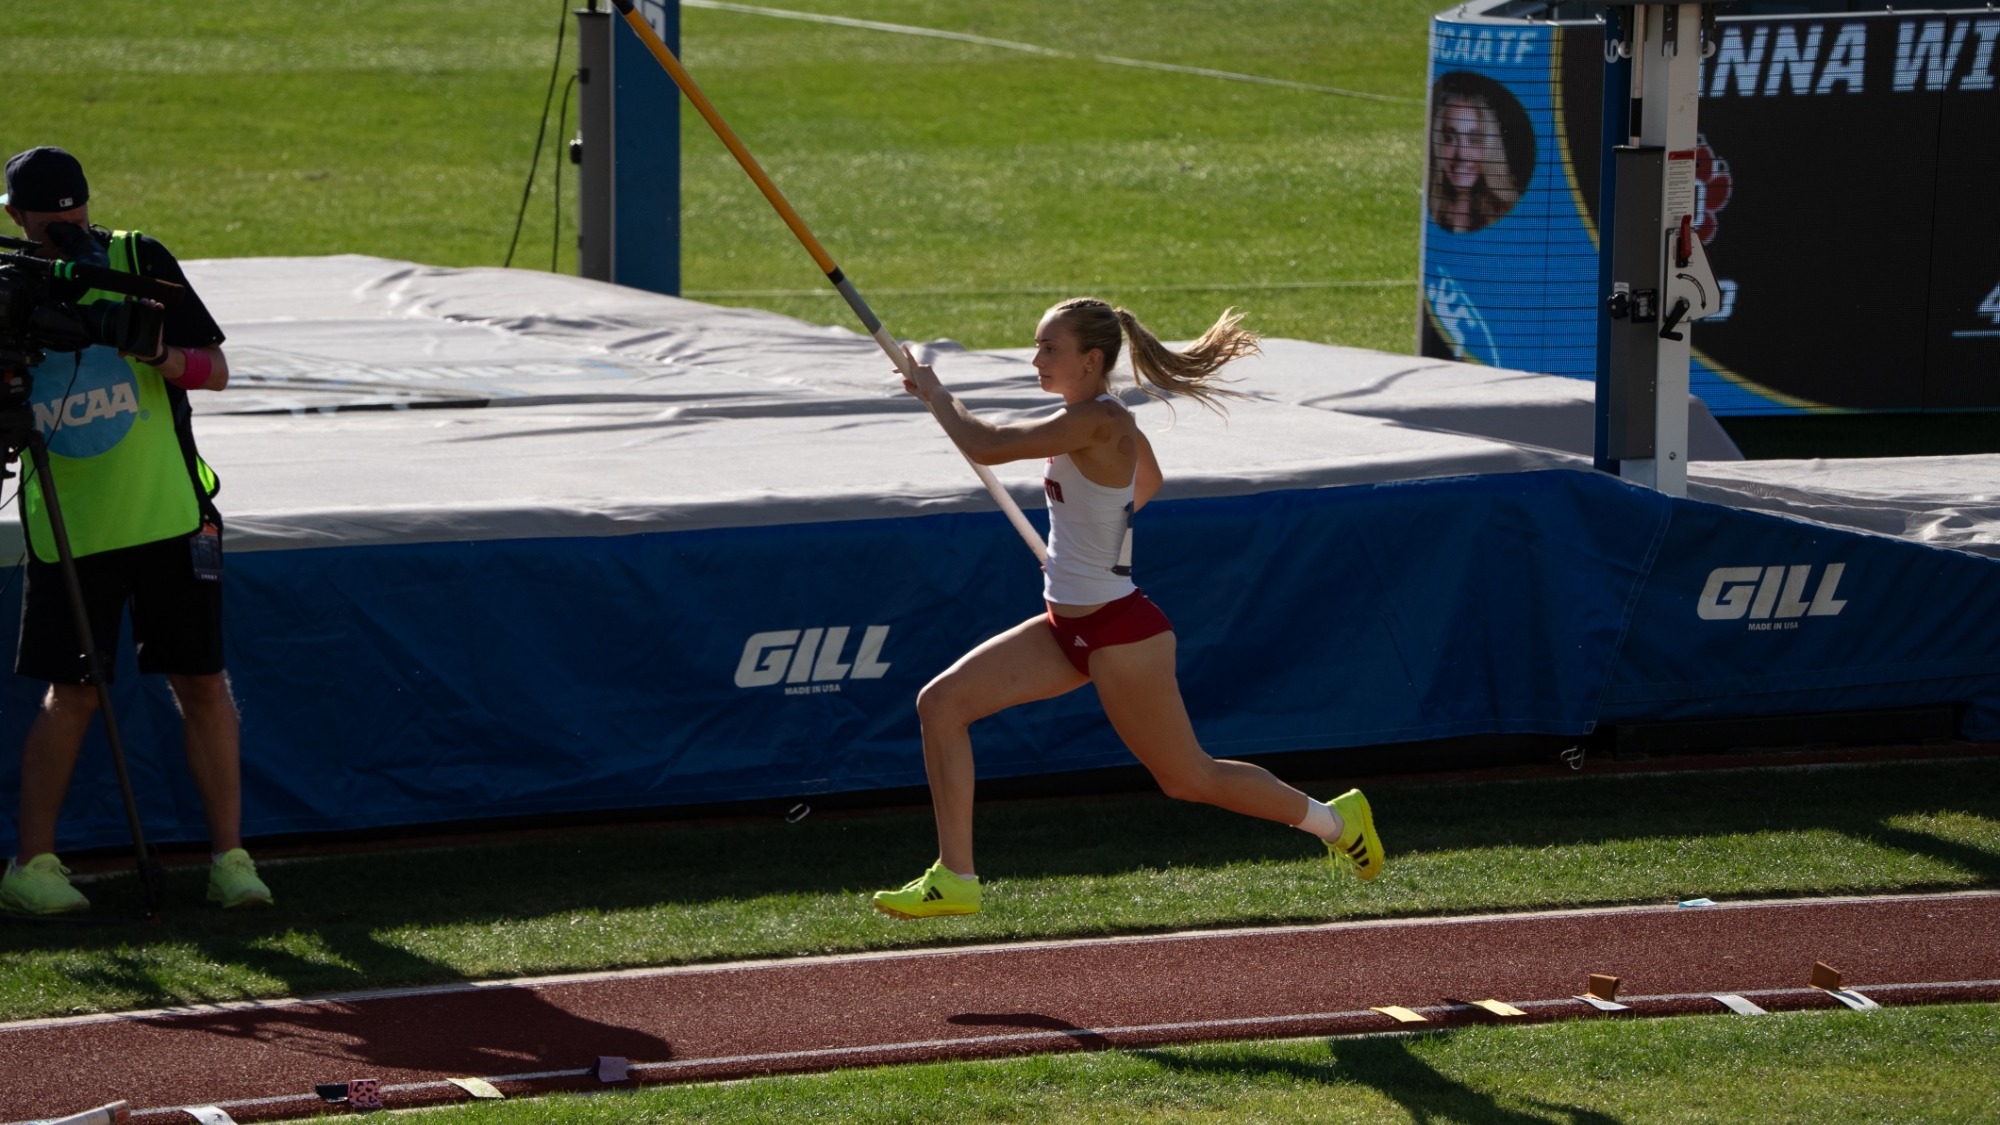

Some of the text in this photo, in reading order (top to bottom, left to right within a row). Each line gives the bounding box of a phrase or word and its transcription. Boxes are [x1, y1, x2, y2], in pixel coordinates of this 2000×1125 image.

[1699, 24, 1867, 97] NNA
[33, 383, 138, 433] NCAA
[1697, 563, 1848, 620] GILL
[1748, 621, 1799, 631] MADE IN USA
[734, 625, 892, 688] GILL
[785, 684, 841, 695] MADE IN USA
